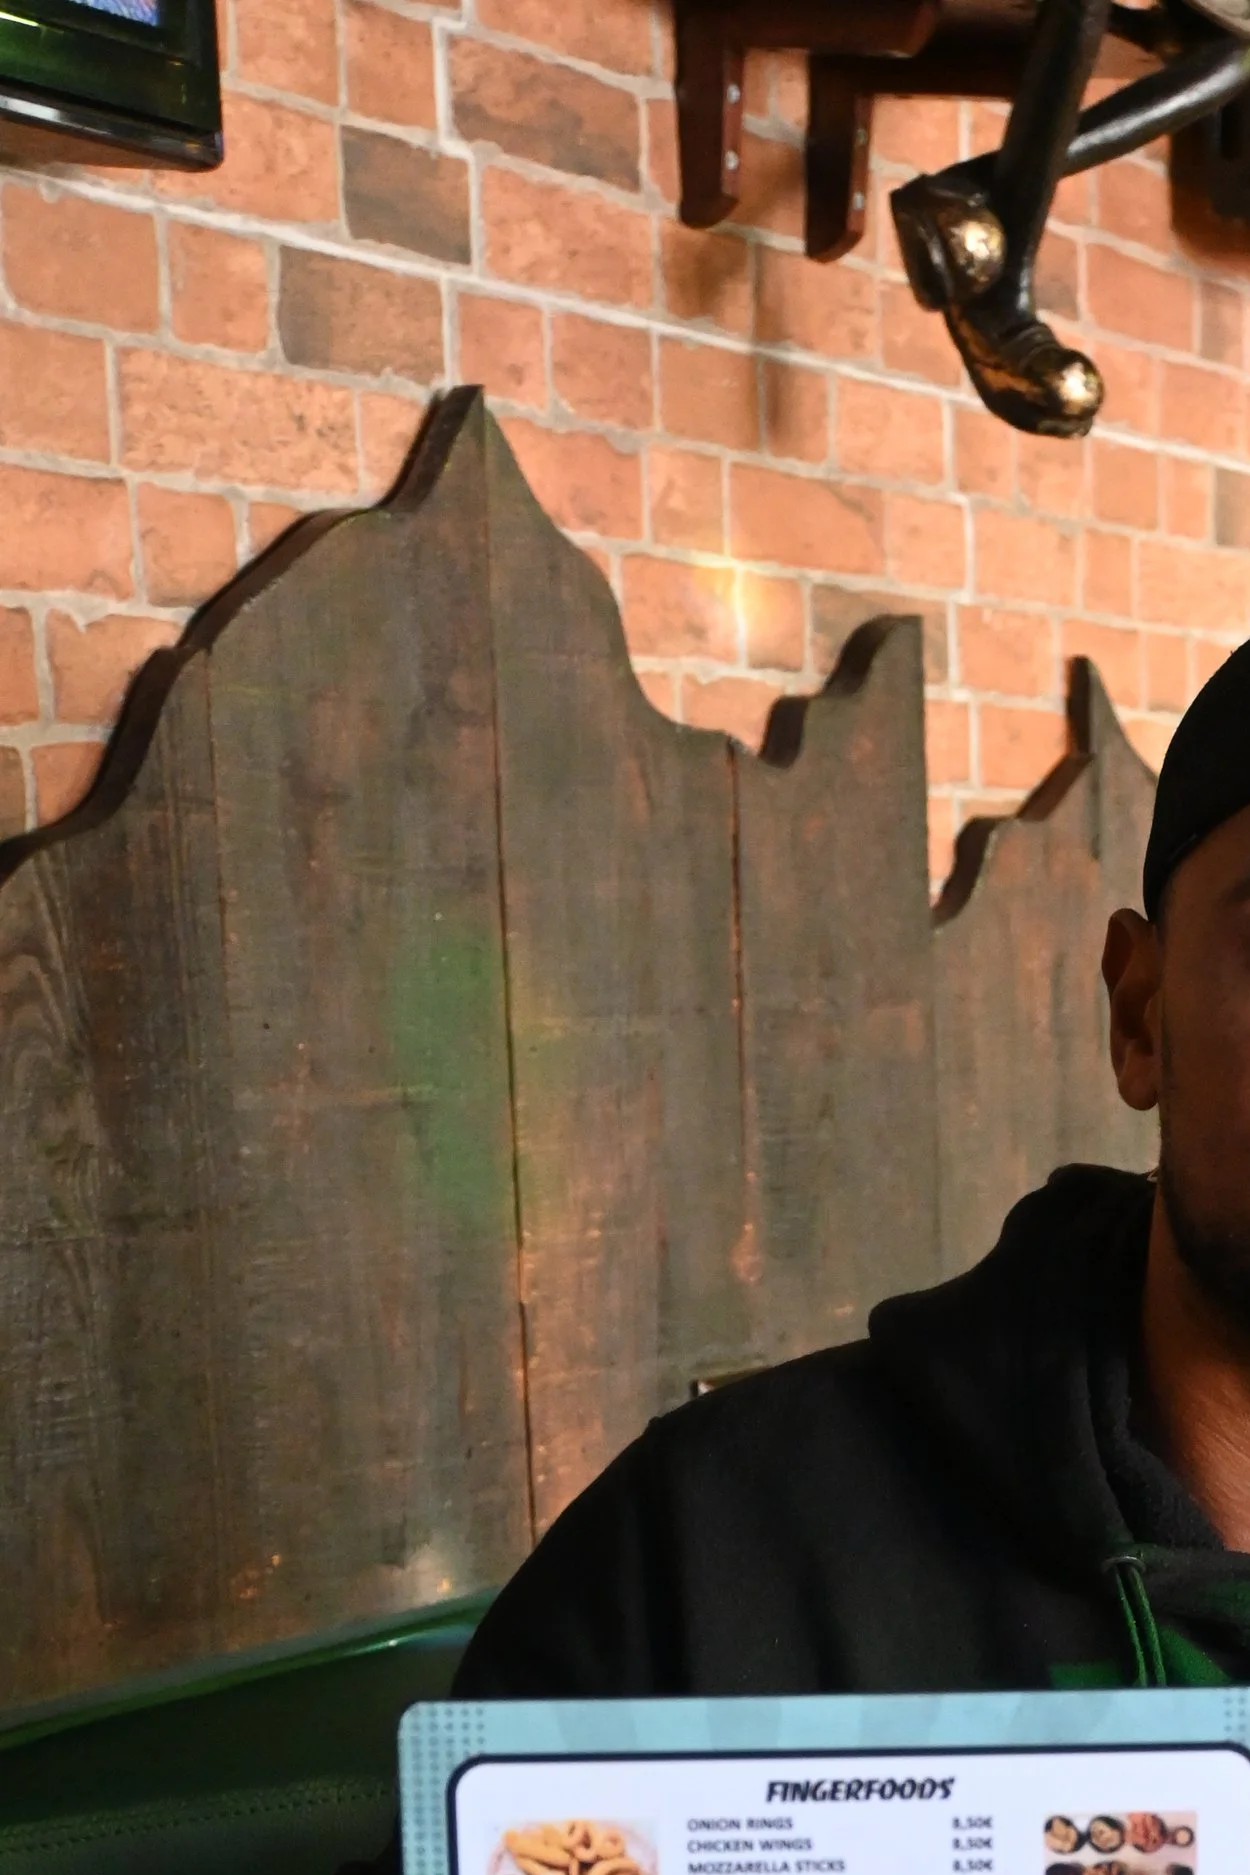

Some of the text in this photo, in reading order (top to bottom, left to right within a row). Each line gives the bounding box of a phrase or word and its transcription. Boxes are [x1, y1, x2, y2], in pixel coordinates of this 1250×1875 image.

[766, 1777, 955, 1802] FINGERFOODS
[687, 1817, 993, 1831] ONION RINGS 8,50€
[687, 1838, 993, 1853] CHICKEN WINGS 8,50€
[688, 1860, 993, 1875] MOZZARELLA STICKS 8,50€
